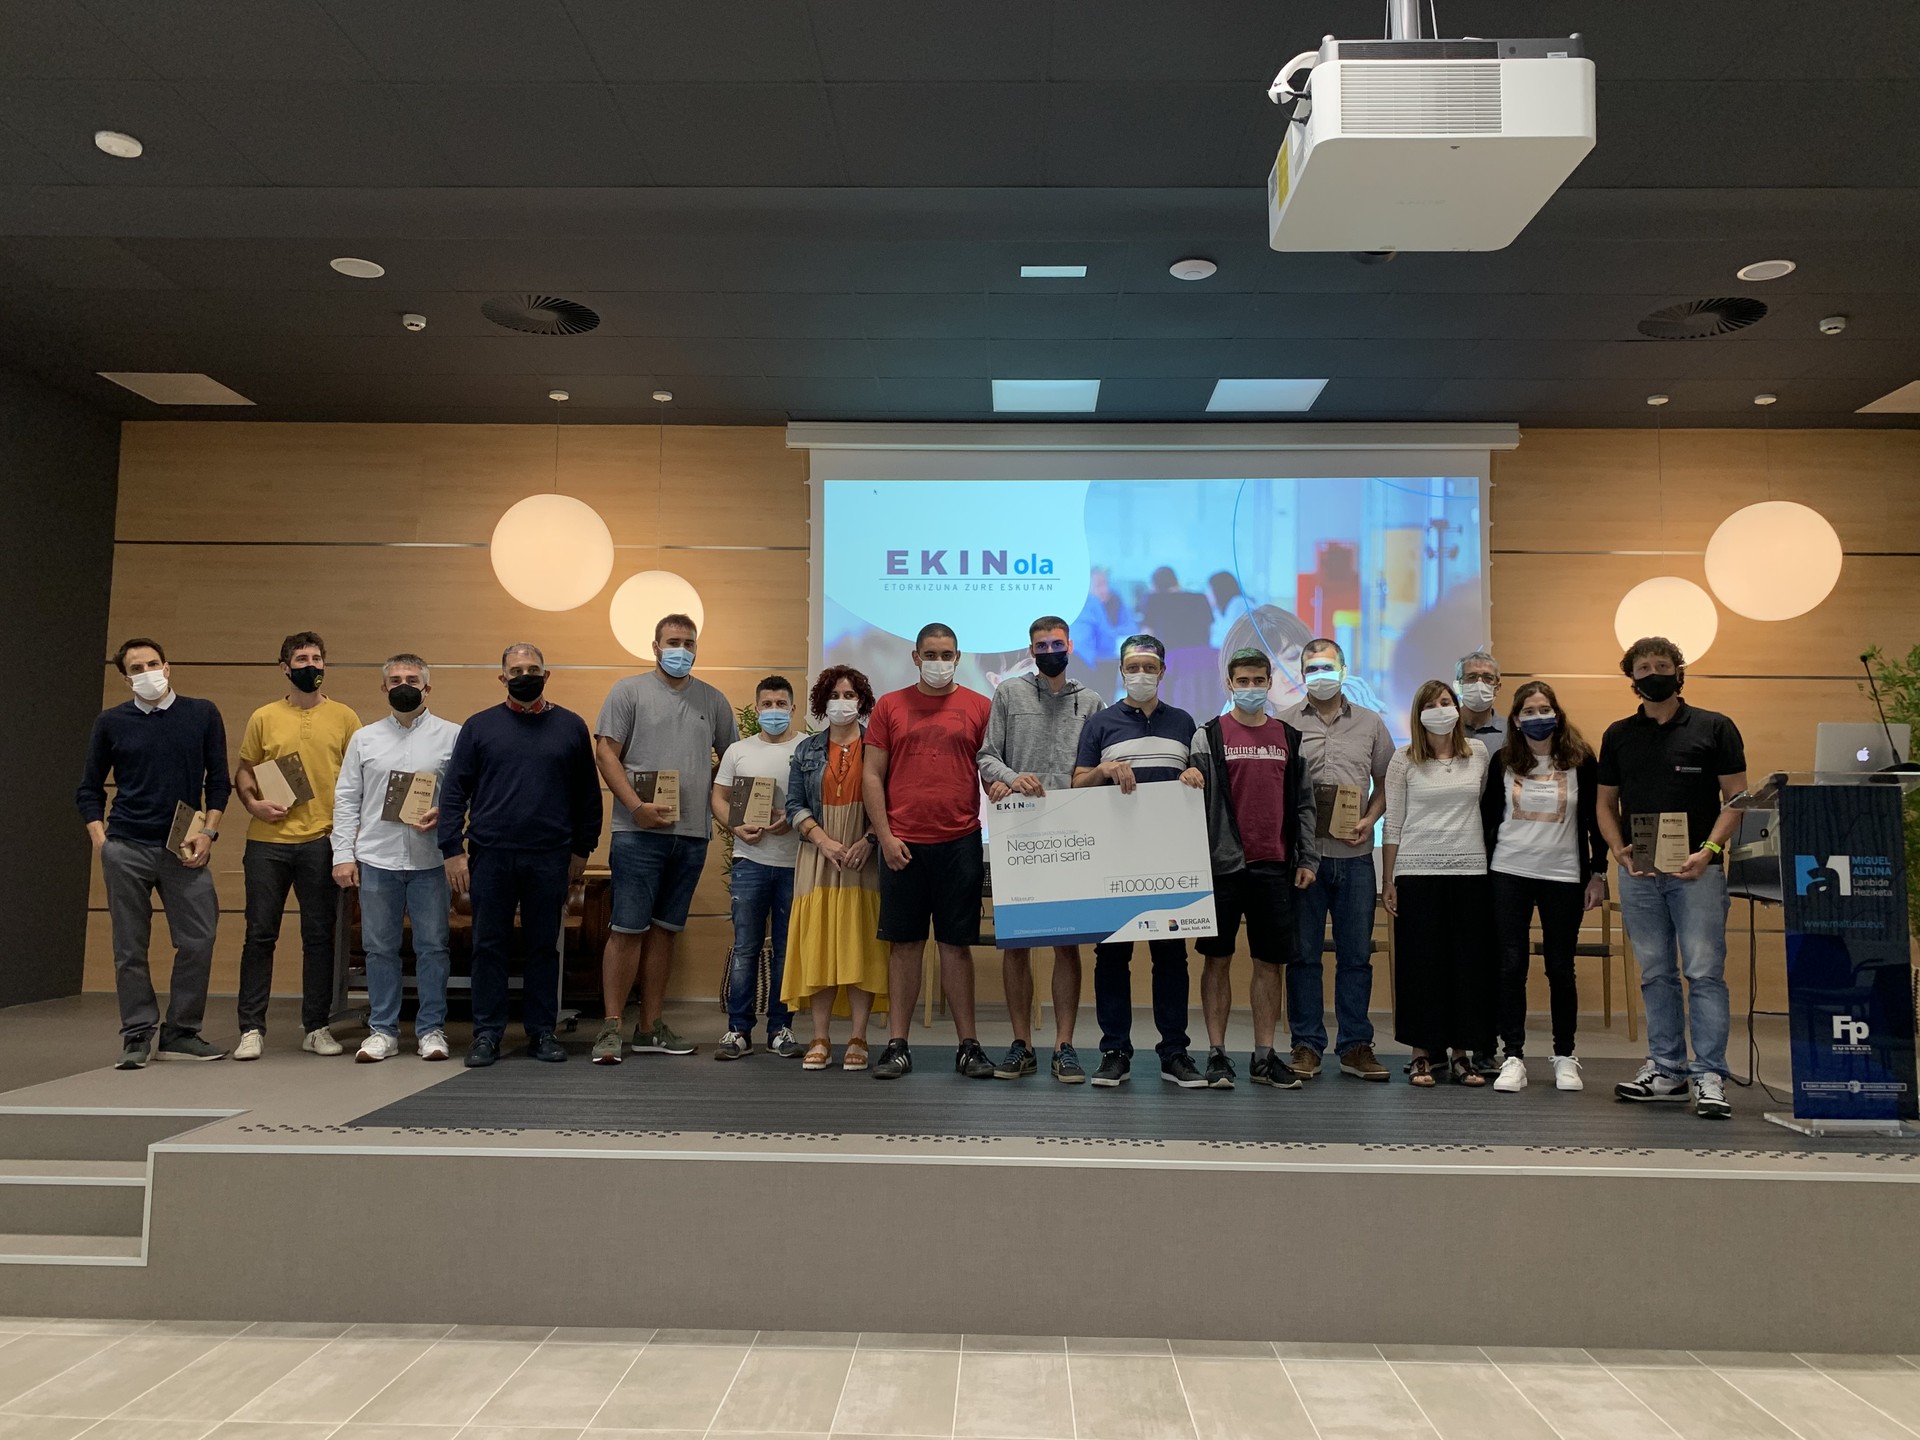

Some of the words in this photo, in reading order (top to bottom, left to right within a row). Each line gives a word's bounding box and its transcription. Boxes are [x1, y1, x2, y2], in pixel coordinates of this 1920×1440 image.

[884, 583, 959, 592] ETORKIZUNA
[965, 583, 994, 592] ZURE
[1000, 583, 1054, 592] ESKUTAN
[1007, 837, 1062, 854] Negozio
[1064, 834, 1095, 847] ideia
[1007, 850, 1058, 866] onenari
[1060, 848, 1091, 862] saria
[1851, 856, 1892, 866] MIGUEL
[1852, 866, 1893, 876] ALTUNA
[1109, 876, 1175, 894] #1.000,00
[1852, 878, 1890, 887] Lanbide
[1853, 888, 1893, 897] Heziketa
[1180, 917, 1211, 926] BERGARA
[1803, 919, 1886, 929] www.maltuna.eus
[1832, 1015, 1870, 1045] Fp
